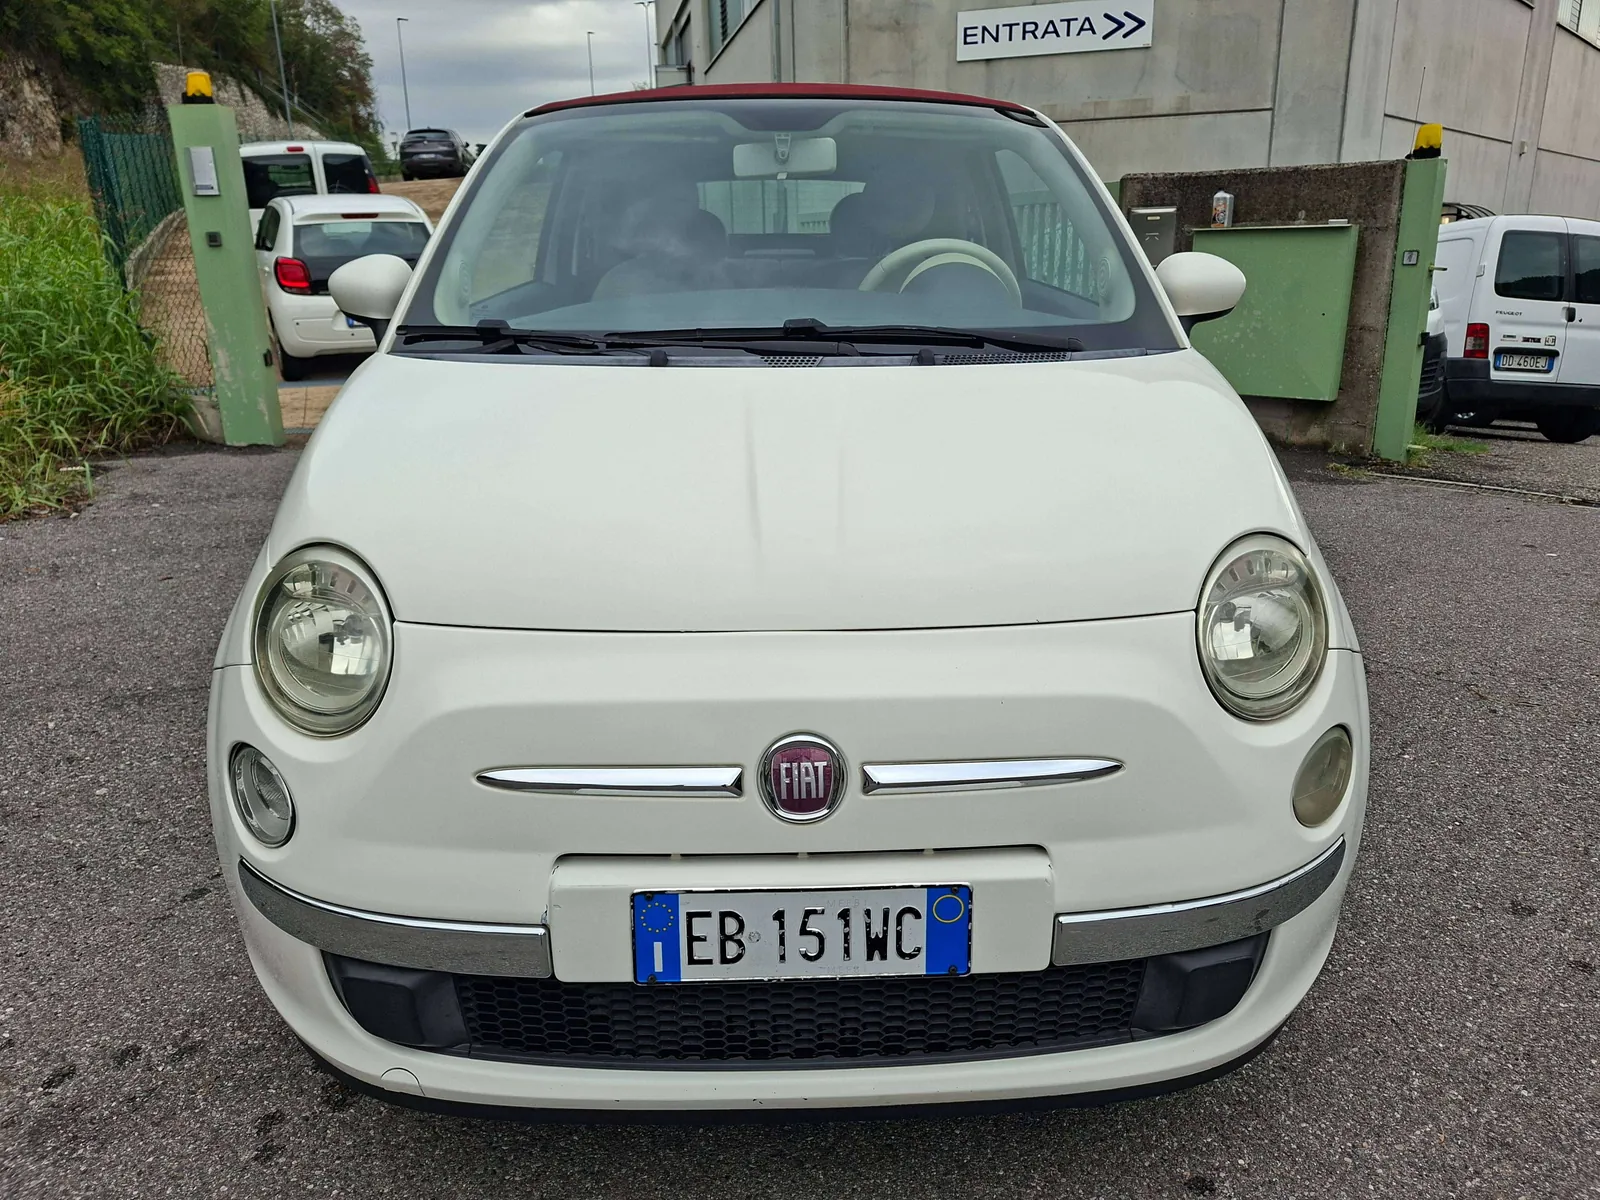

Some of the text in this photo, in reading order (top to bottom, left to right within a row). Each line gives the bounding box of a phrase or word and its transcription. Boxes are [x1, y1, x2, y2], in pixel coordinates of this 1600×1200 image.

[963, 17, 1097, 45] ENTRATA
[1502, 355, 1548, 368] DD 460EJ
[780, 761, 827, 799] FIAT
[686, 907, 922, 965] EB 151WC
[653, 941, 663, 972] I
